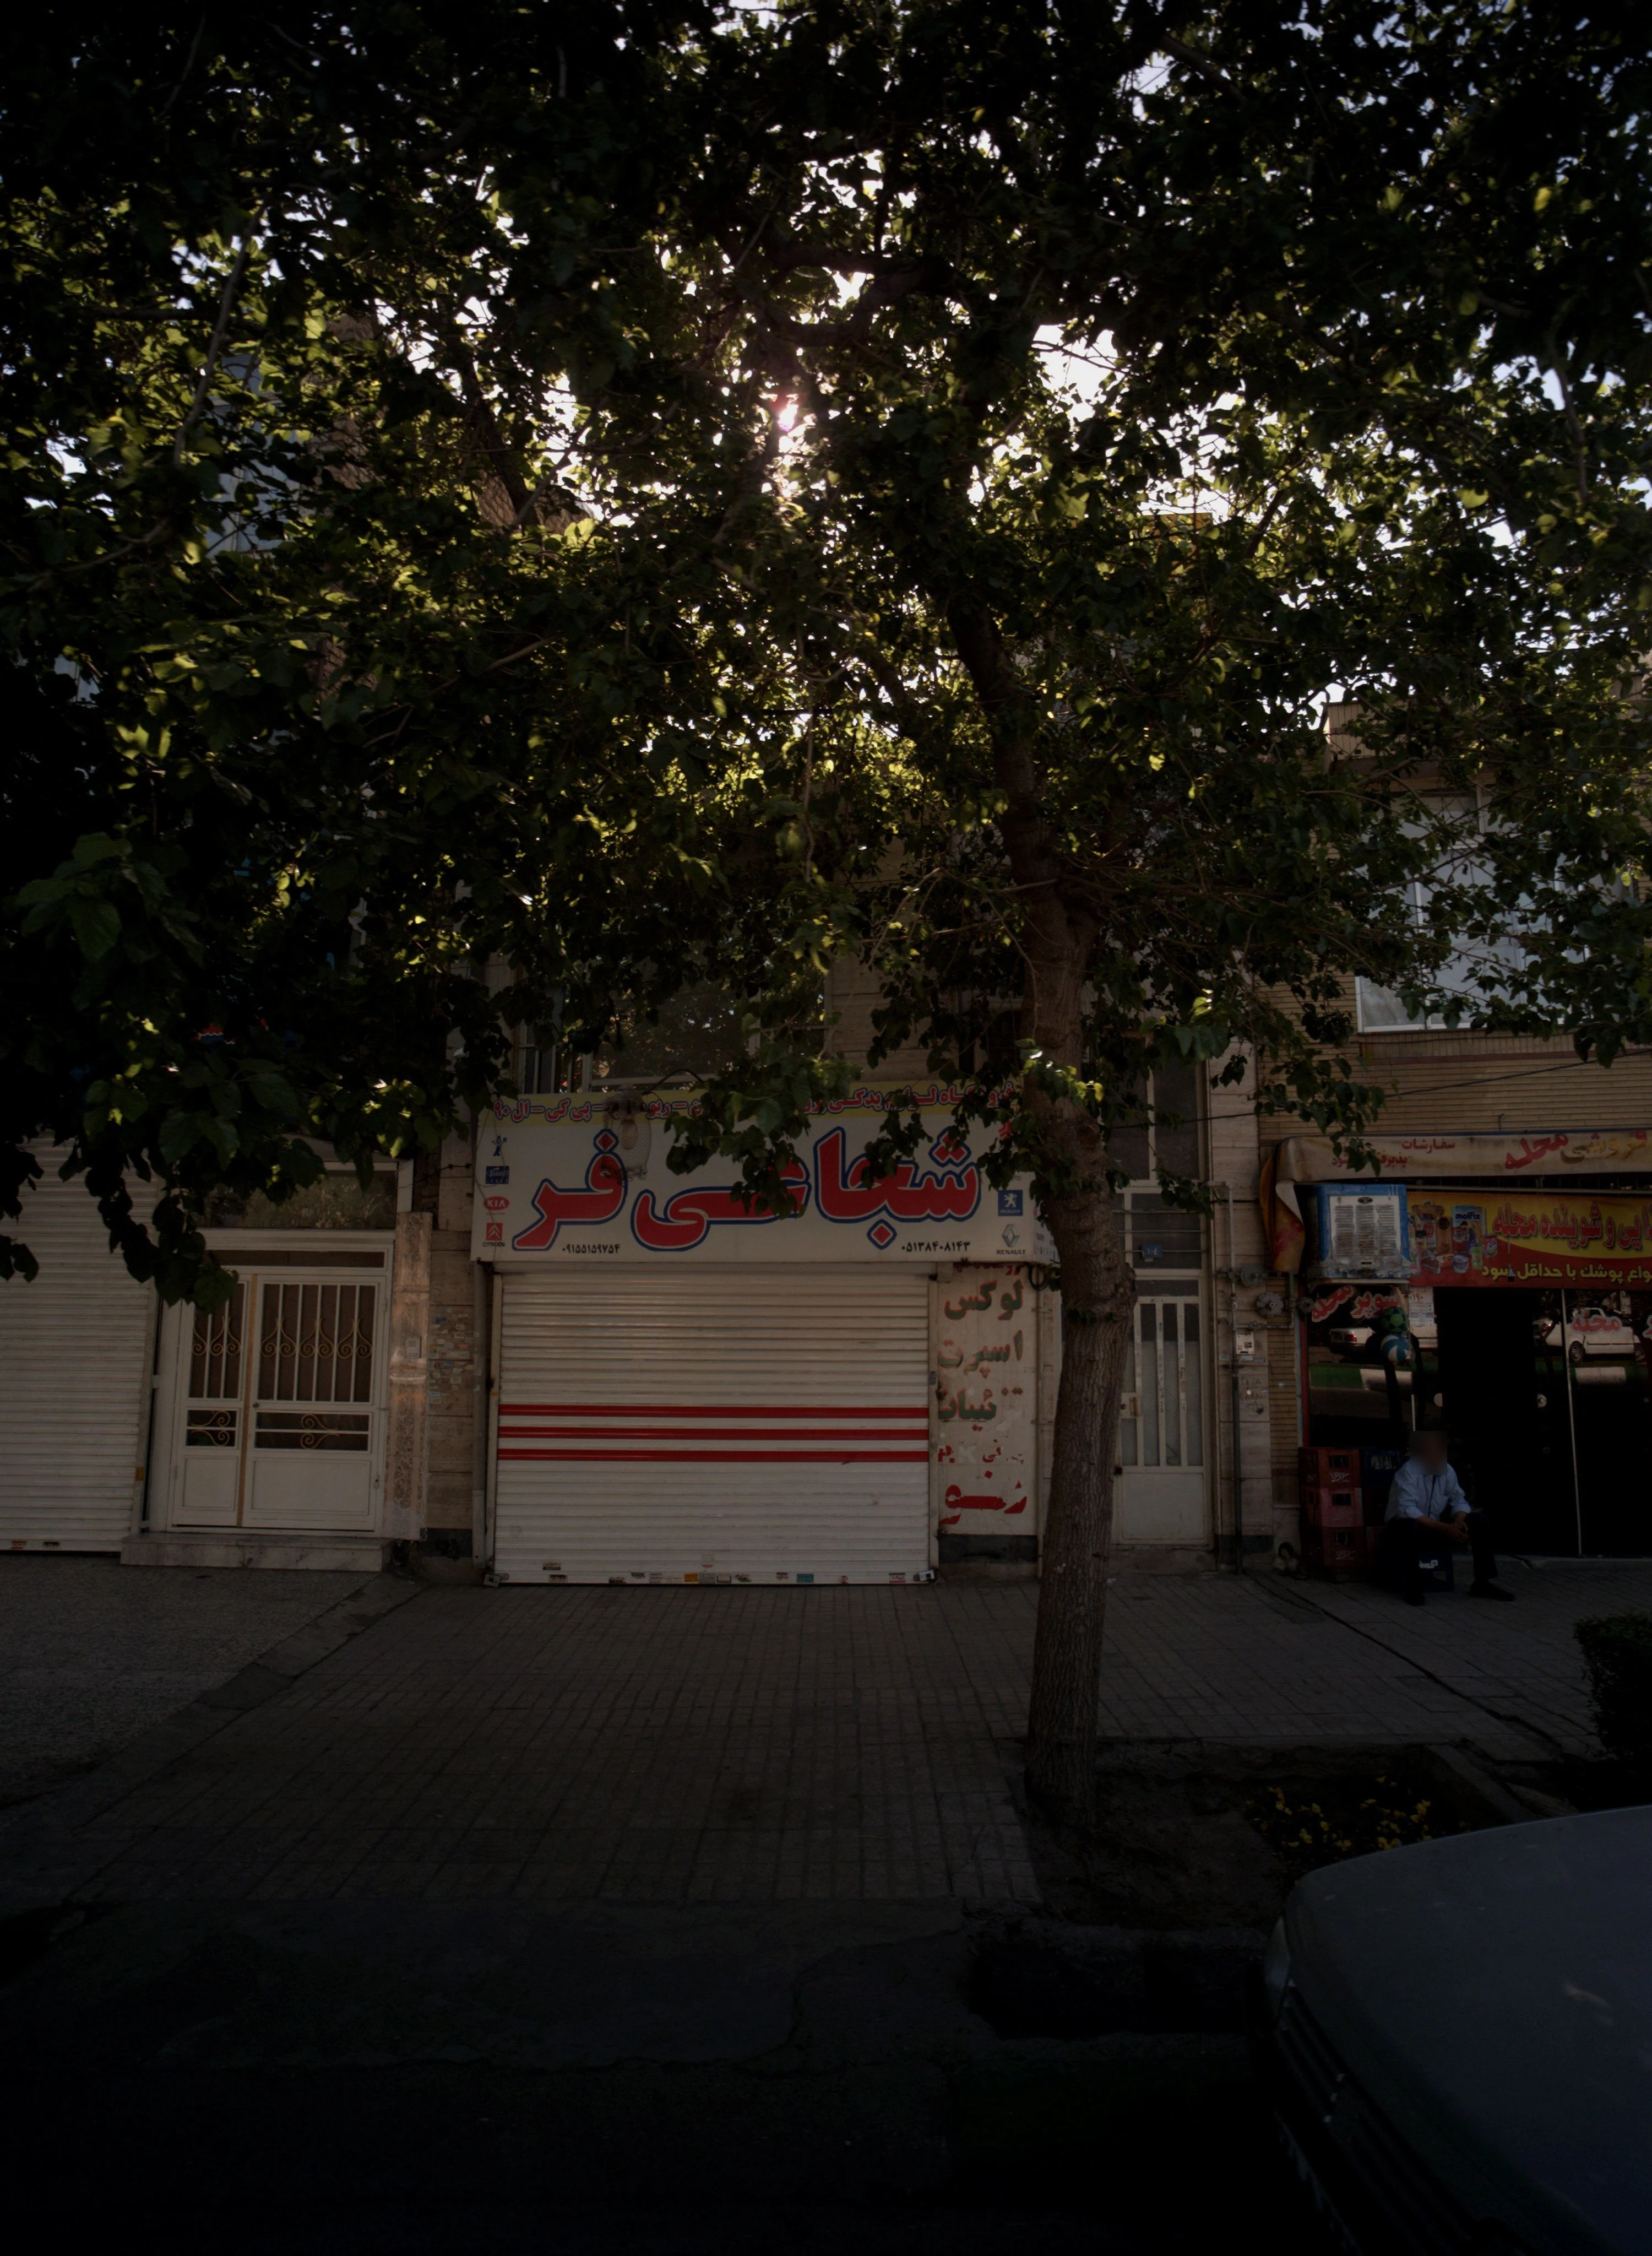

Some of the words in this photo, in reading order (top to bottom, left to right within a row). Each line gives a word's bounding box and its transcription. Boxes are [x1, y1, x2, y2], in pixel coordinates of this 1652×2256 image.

[828, 1087, 883, 1114] یدکی
[1401, 1138, 1456, 1154] سفارشات
[1505, 1133, 1568, 1170] محله
[512, 1129, 628, 1251] فر
[1493, 1203, 1537, 1237] محله
[1540, 1203, 1602, 1248] شوینده
[1604, 1217, 1615, 1248] و
[902, 1241, 970, 1252] ۰۵۱۳۸۴۰۸۱۴۳
[1517, 1263, 1563, 1280] حداقل
[1566, 1263, 1577, 1281] با
[944, 1279, 1024, 1320] لوکس
[1569, 1309, 1623, 1333] محله
